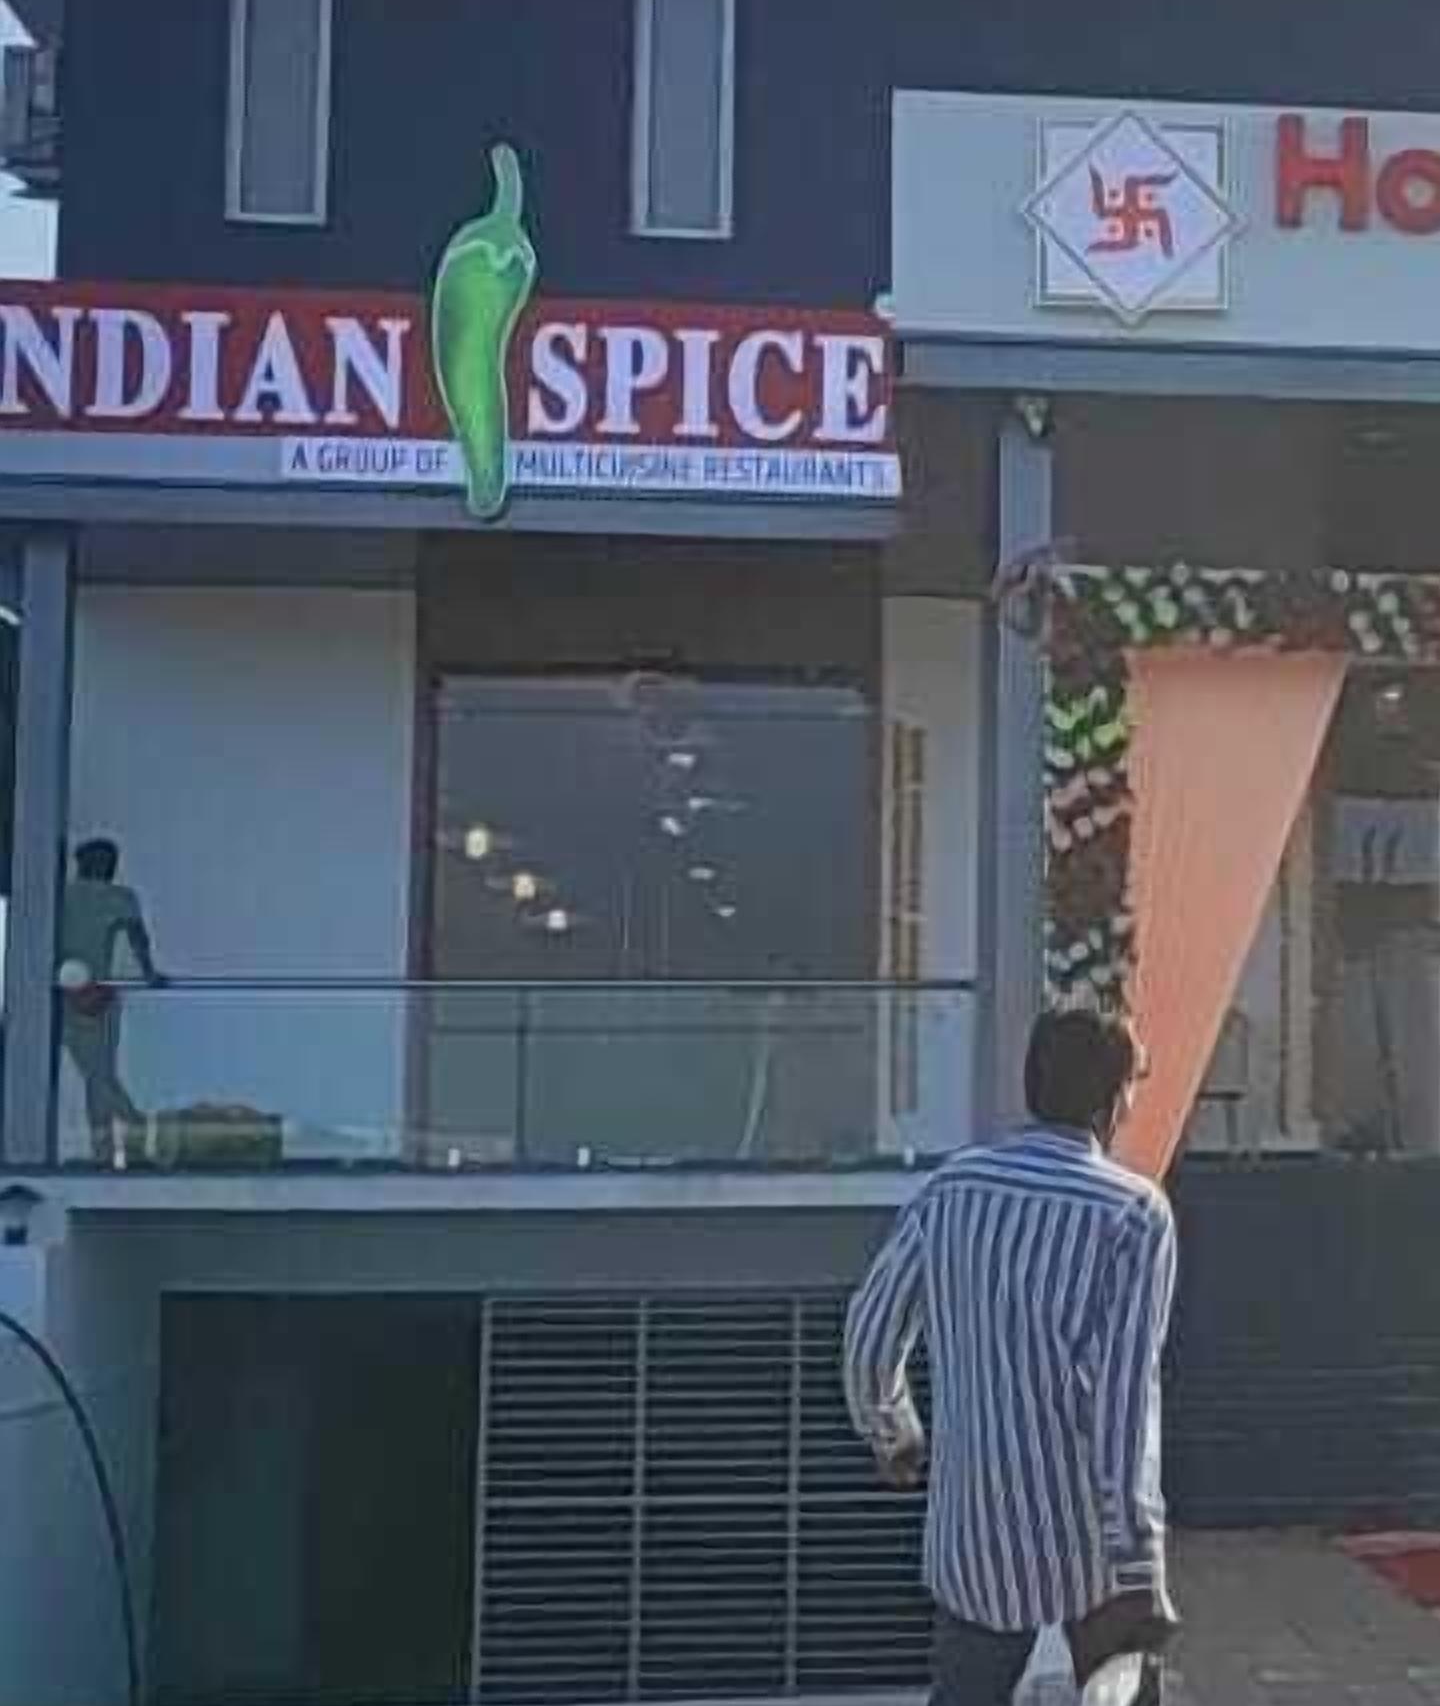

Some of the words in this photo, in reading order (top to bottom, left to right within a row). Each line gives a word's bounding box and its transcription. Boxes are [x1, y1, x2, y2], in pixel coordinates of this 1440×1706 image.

[527, 321, 887, 443] SPICE
[290, 442, 309, 471] A
[316, 443, 408, 474] GROUP
[415, 447, 449, 474] OF
